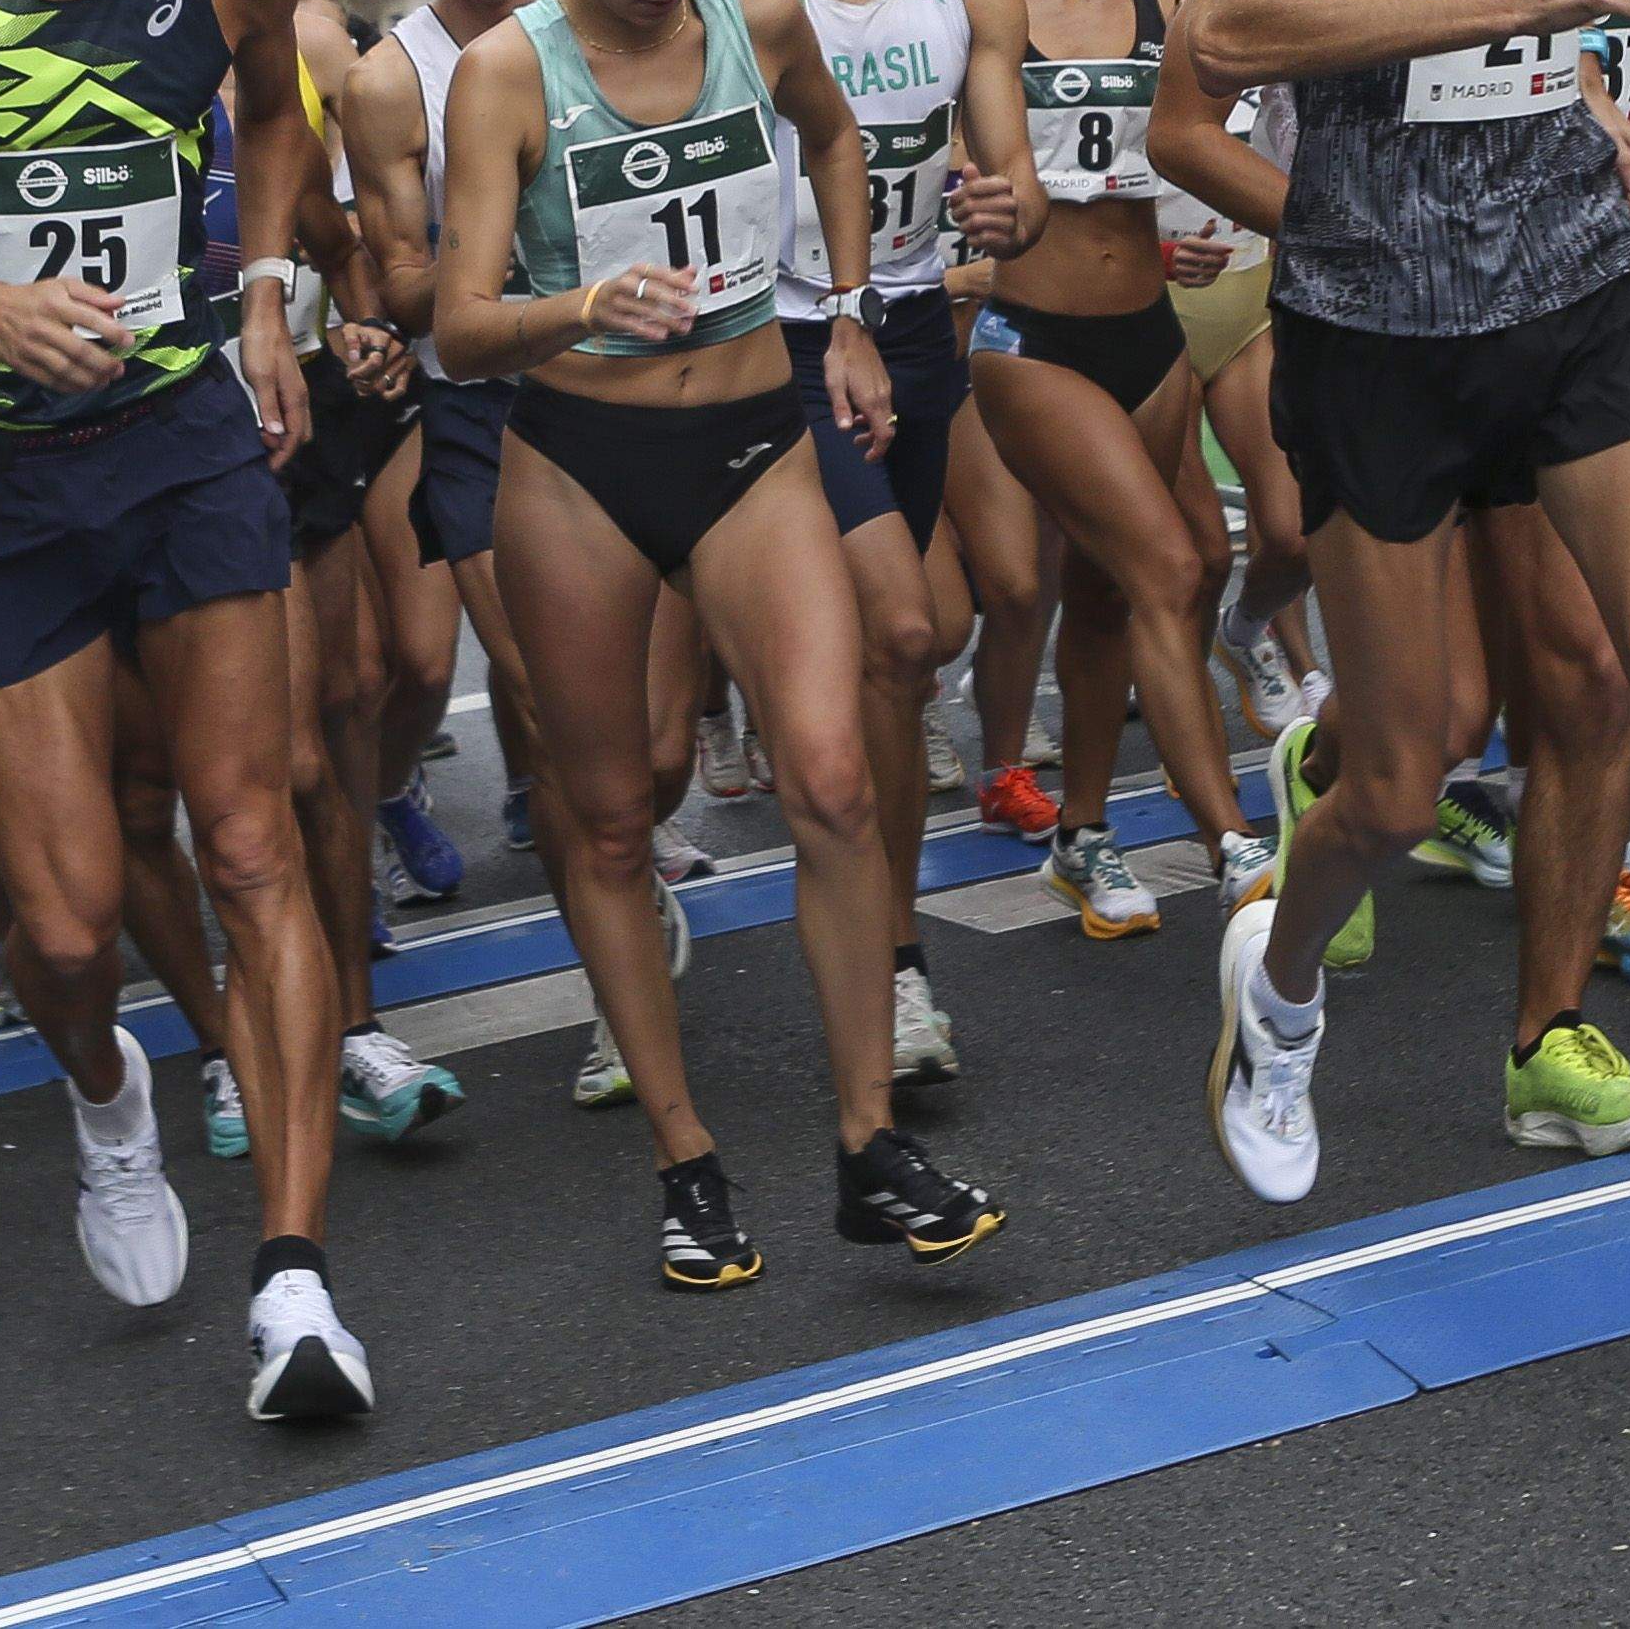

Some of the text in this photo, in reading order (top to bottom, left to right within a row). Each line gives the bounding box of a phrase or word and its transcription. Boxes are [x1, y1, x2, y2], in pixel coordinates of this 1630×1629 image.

[1451, 81, 1514, 99] MADRID
[1077, 111, 1113, 172] 8
[83, 165, 130, 185] Silbö
[1043, 178, 1090, 189] MADRID
[650, 188, 722, 270] 11
[29, 215, 127, 294] 25
